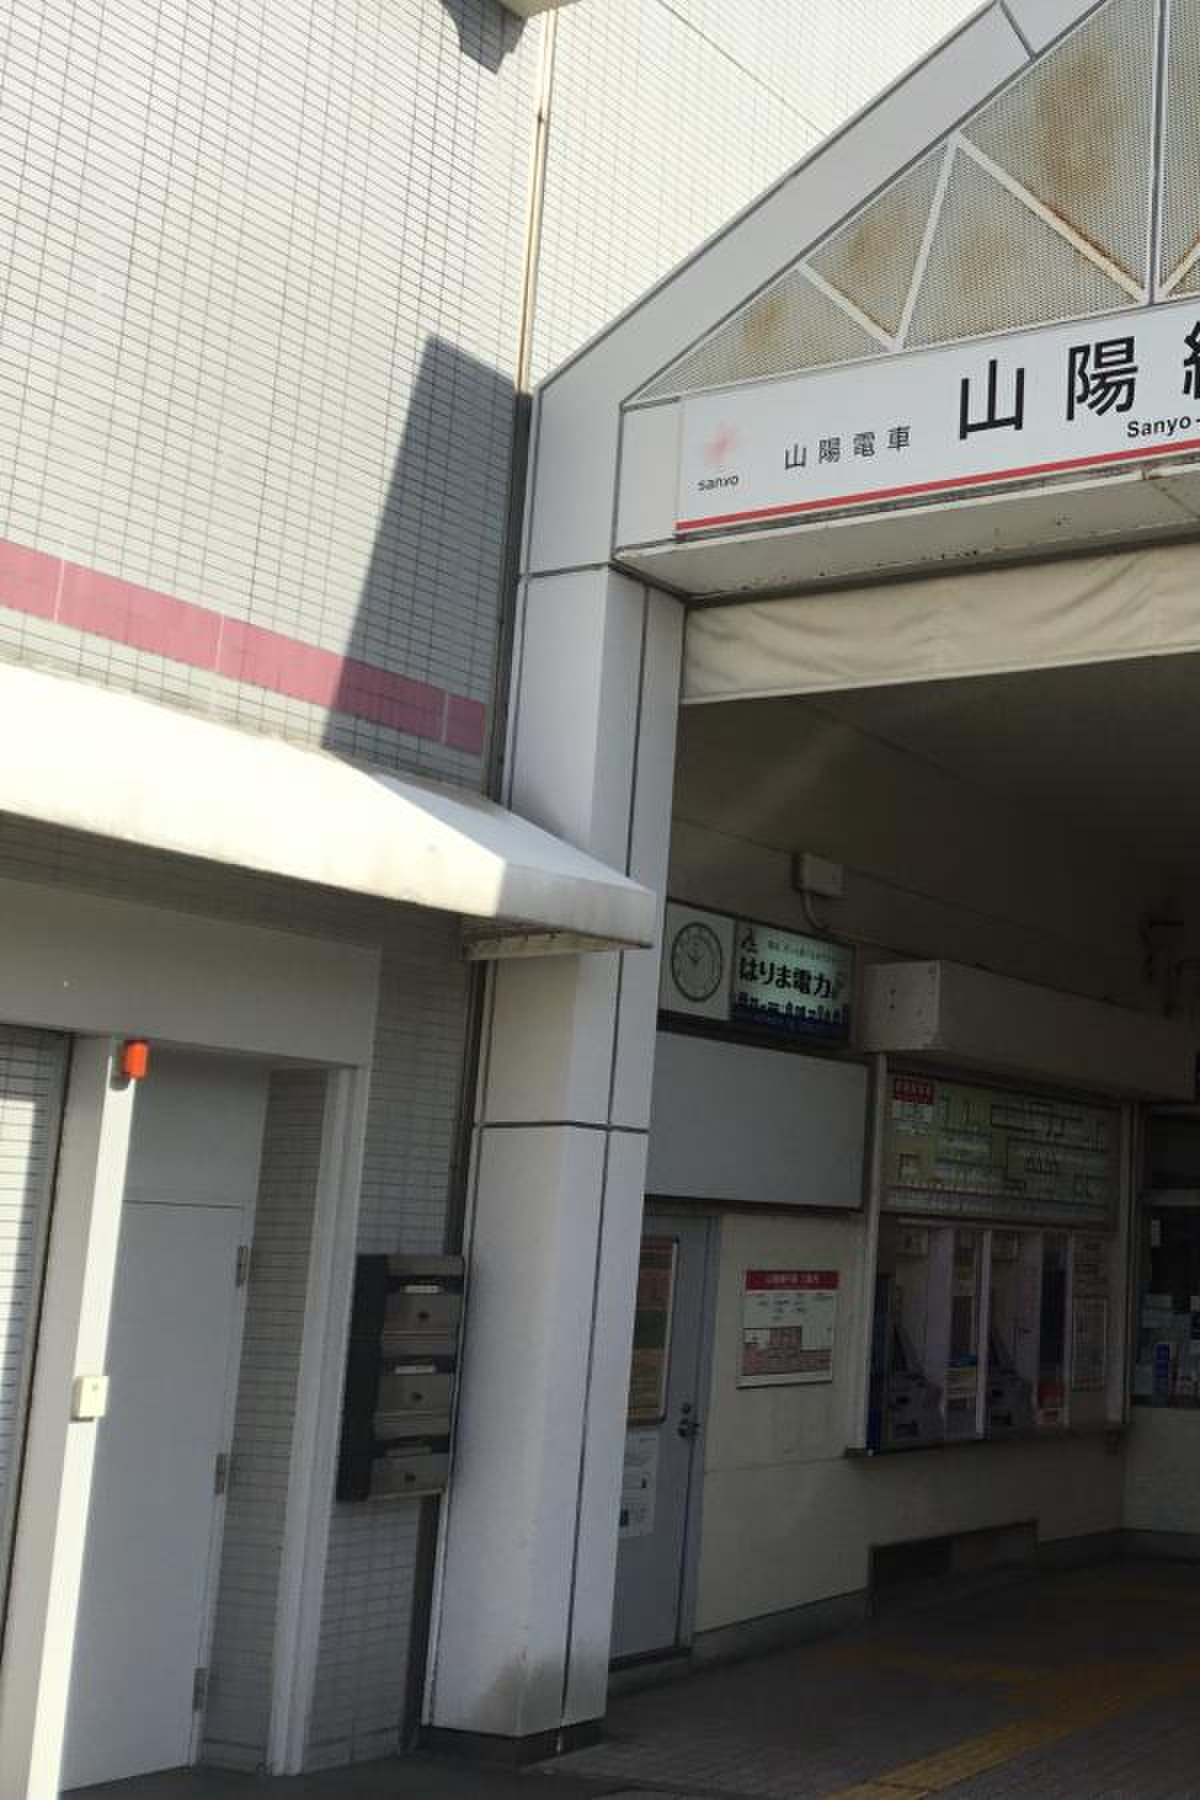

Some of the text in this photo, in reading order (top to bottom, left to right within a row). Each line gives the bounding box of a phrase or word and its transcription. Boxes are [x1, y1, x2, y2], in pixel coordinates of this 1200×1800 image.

[784, 426, 911, 470] 山陽電車
[697, 474, 740, 492] sanyo
